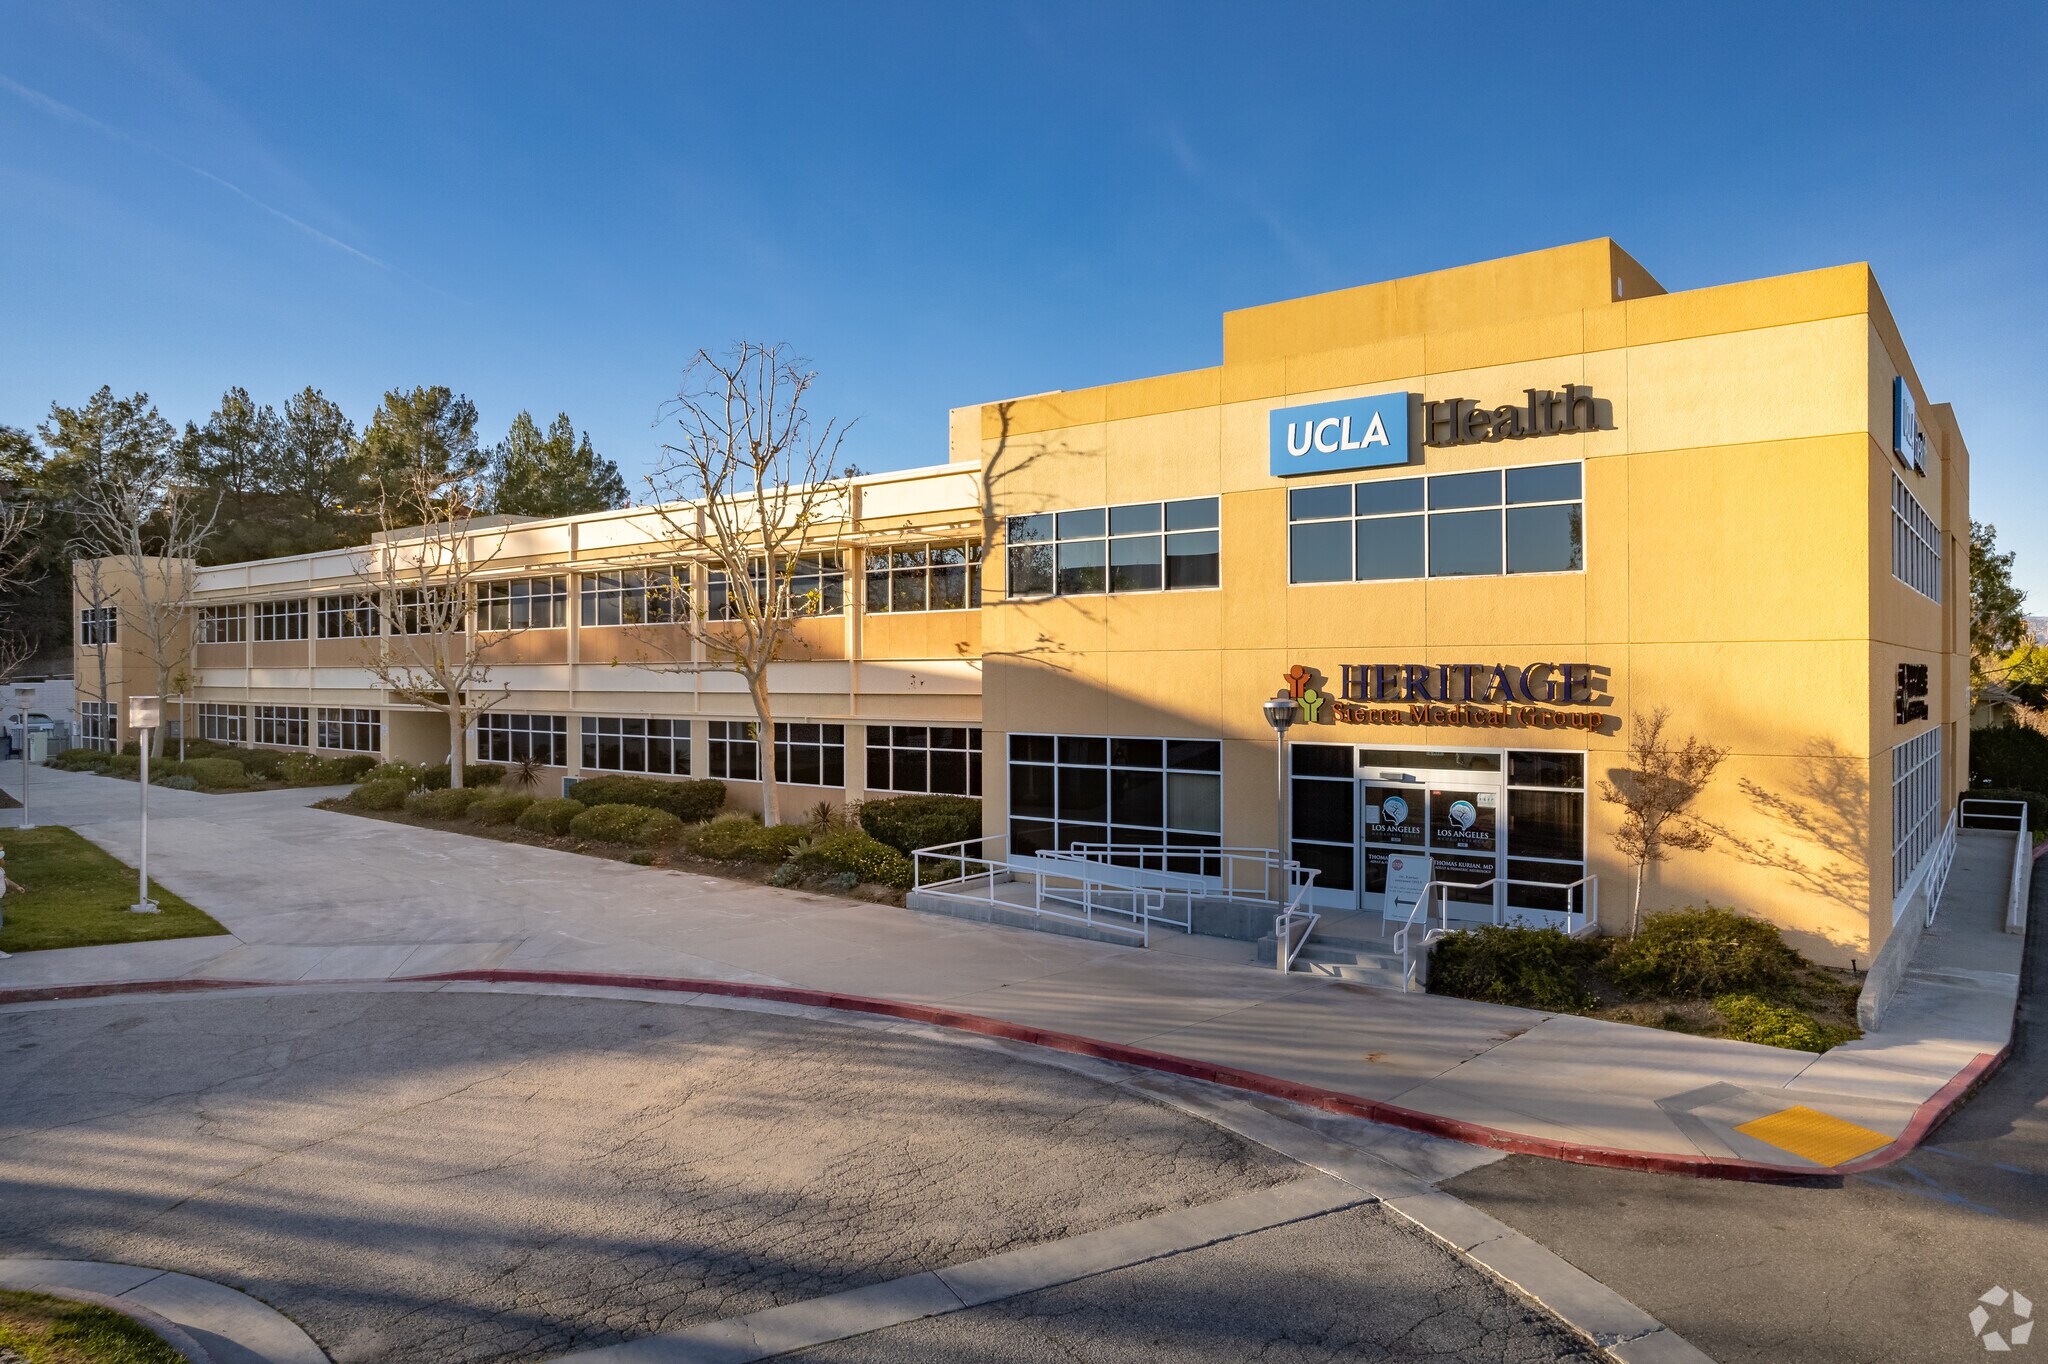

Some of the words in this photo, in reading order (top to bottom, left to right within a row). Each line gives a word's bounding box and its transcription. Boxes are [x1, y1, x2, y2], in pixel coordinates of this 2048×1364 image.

[1287, 411, 1391, 457] UCLA
[1421, 383, 1600, 446] Health
[1339, 662, 1591, 703] HERITAGE
[1331, 702, 1401, 723] Sierra
[1410, 704, 1507, 726] Medical
[1516, 705, 1603, 732] Group
[1387, 825, 1420, 834] ANGELES
[1437, 829, 1452, 837] LOS
[1453, 830, 1489, 840] ANGELES
